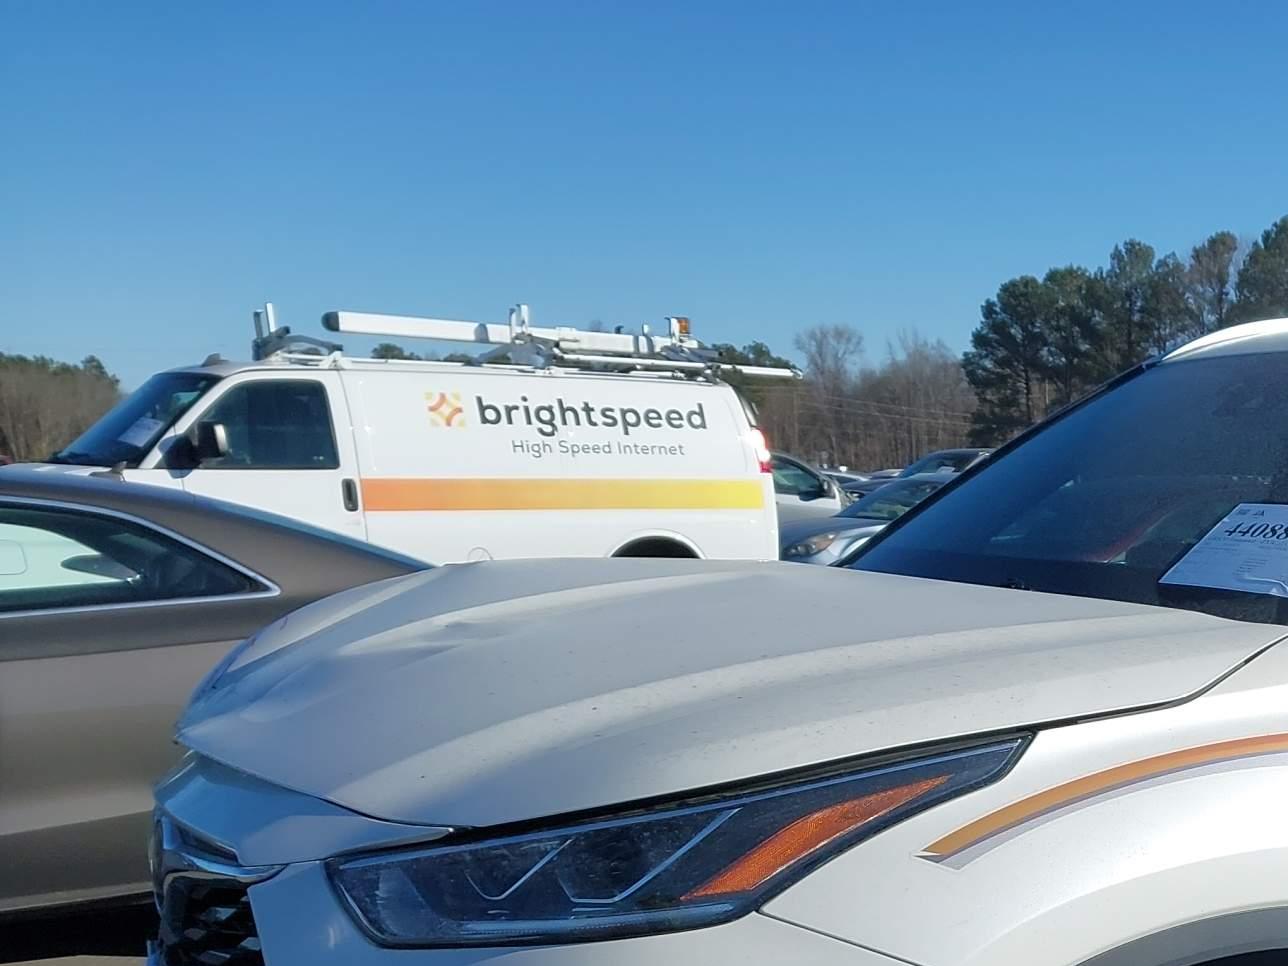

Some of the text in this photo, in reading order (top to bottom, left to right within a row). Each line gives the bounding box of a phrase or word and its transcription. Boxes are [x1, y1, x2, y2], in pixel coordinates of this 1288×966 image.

[476, 396, 707, 437] brightspeed
[512, 440, 685, 458] High Speed Internet
